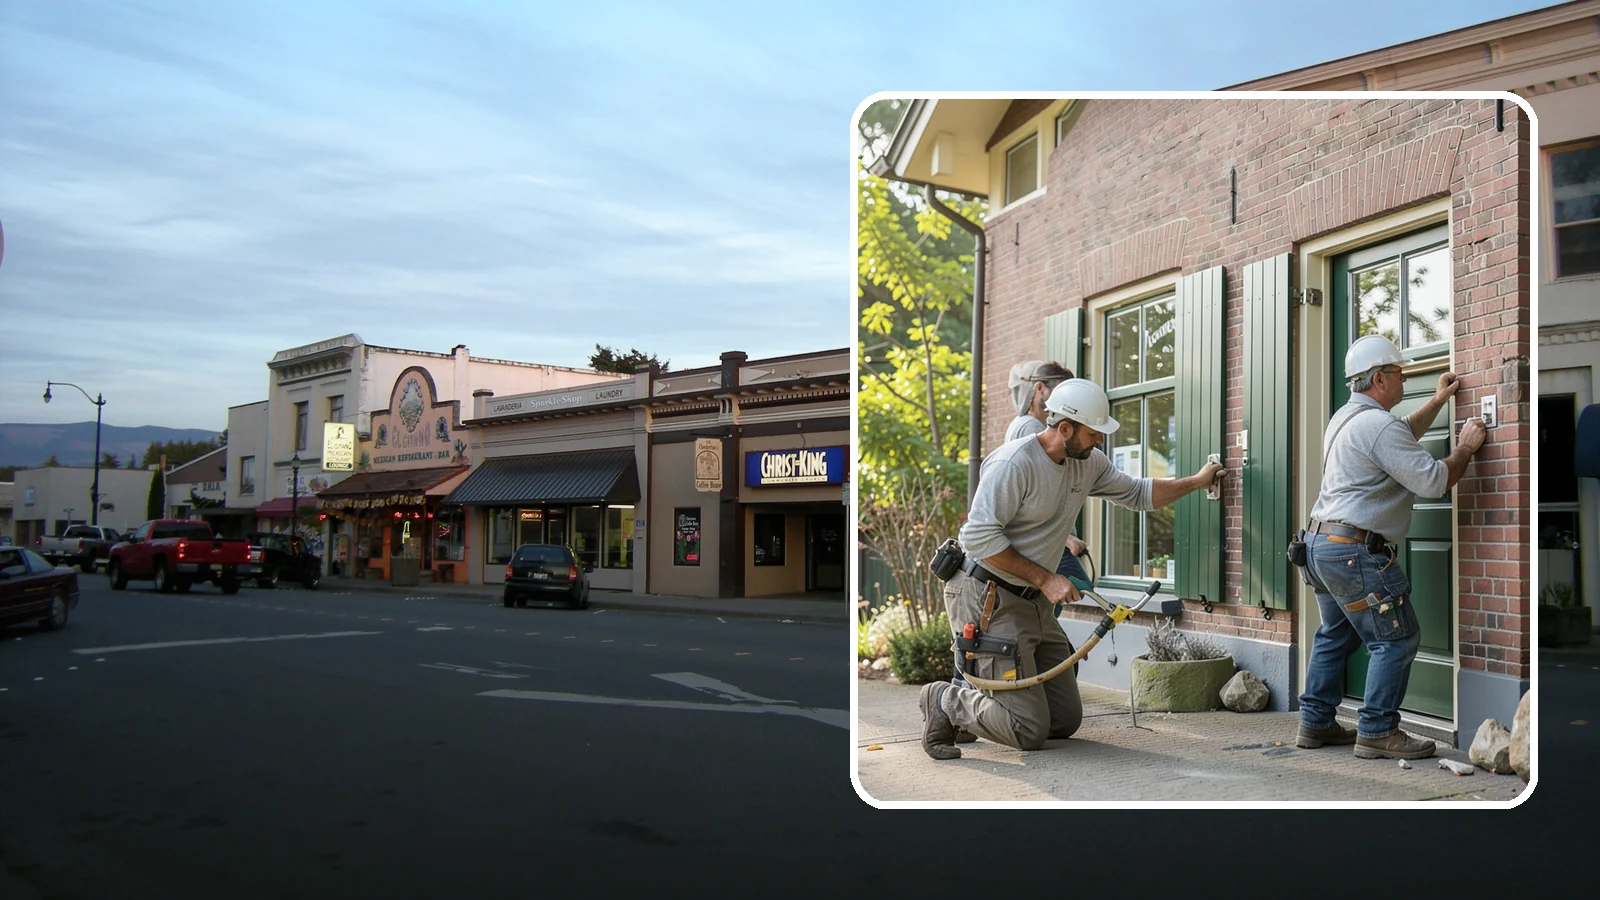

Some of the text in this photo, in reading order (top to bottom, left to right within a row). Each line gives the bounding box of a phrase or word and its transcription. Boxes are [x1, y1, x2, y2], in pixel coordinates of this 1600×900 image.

[561, 395, 582, 405] Shop
[595, 389, 623, 400] LAUNDRY
[493, 402, 522, 412] LAVANDERIA
[373, 450, 450, 464] MEXICAN RESTAURANT BAR
[760, 450, 827, 478] CHRIST KING
